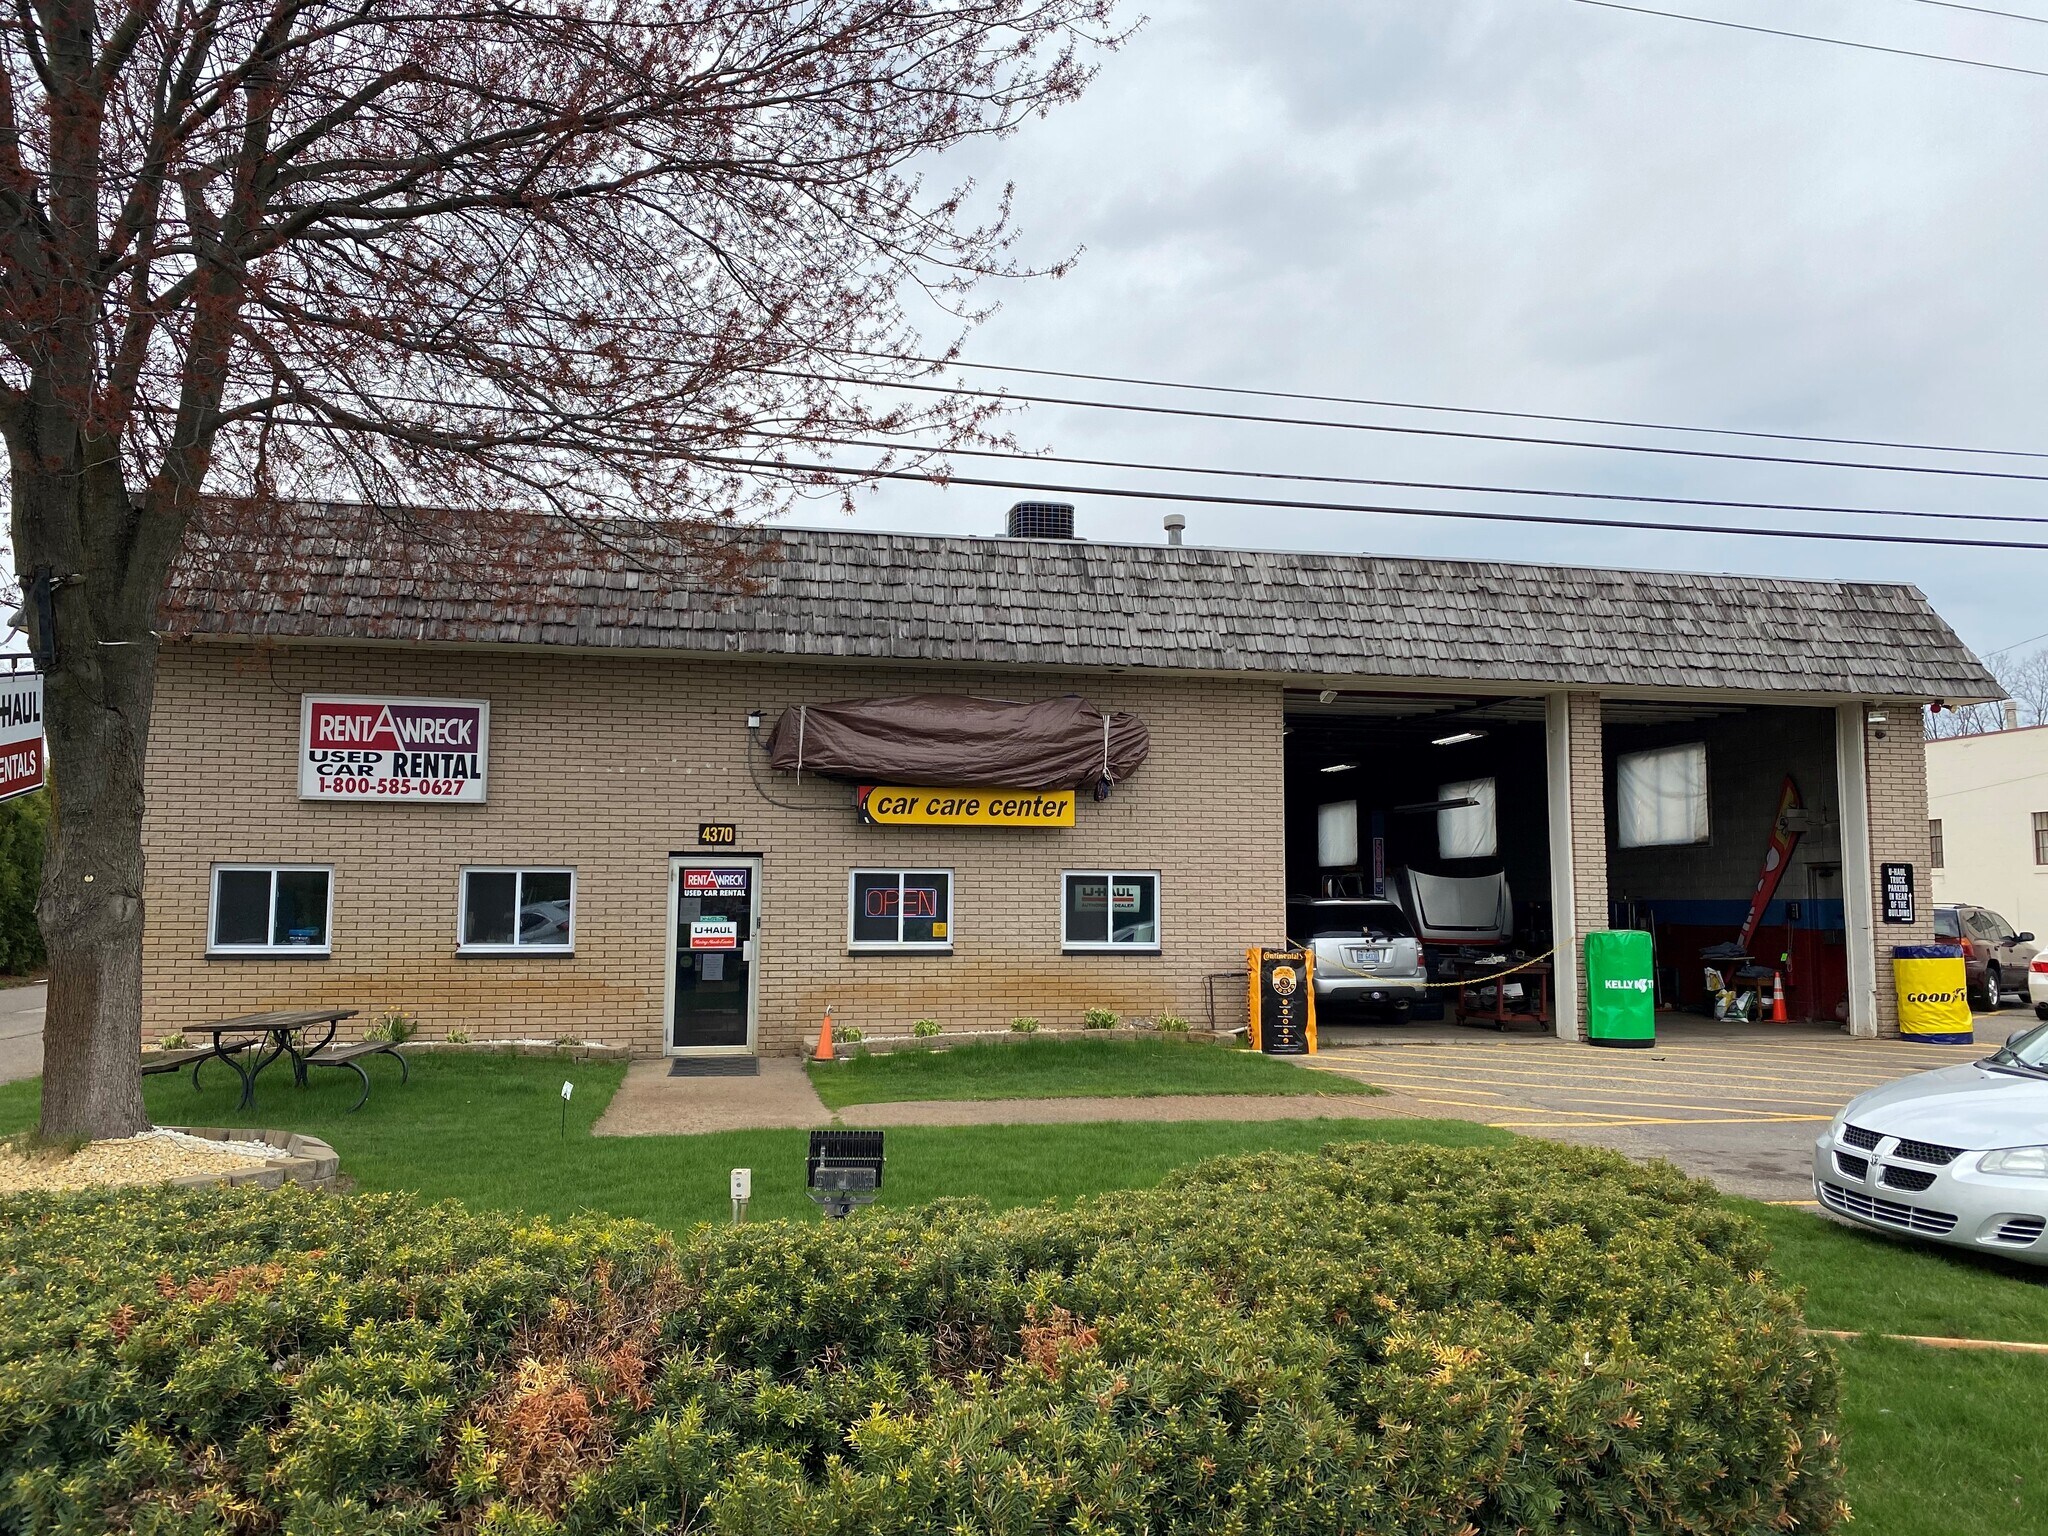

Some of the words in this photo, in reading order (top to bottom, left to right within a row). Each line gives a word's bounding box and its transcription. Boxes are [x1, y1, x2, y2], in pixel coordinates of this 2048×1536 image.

[0, 691, 40, 728] -HAUL
[309, 751, 383, 763] USED
[0, 749, 36, 784] ENTALS
[316, 764, 374, 776] CAR
[392, 752, 481, 779] RENTAL
[319, 777, 465, 796] 1-800-585-0627
[877, 797, 919, 815] car
[925, 798, 980, 816] care
[988, 795, 1068, 818] center
[701, 826, 733, 842] 4370
[1888, 868, 1907, 876] U-HAUL
[1890, 876, 1906, 884] TRUCK
[684, 889, 702, 897] USED
[703, 889, 718, 897] CAR
[719, 889, 746, 897] RENTAL
[1887, 884, 1909, 892] PARKING
[1895, 893, 1908, 901] REAR
[867, 890, 935, 916] OPEN
[1890, 901, 1897, 909] OF
[1898, 901, 1908, 909] THE
[1888, 909, 1910, 917] BUILDING
[694, 926, 733, 934] U-HAUL
[1263, 951, 1299, 961] Continental
[1604, 979, 1633, 989] KELLY
